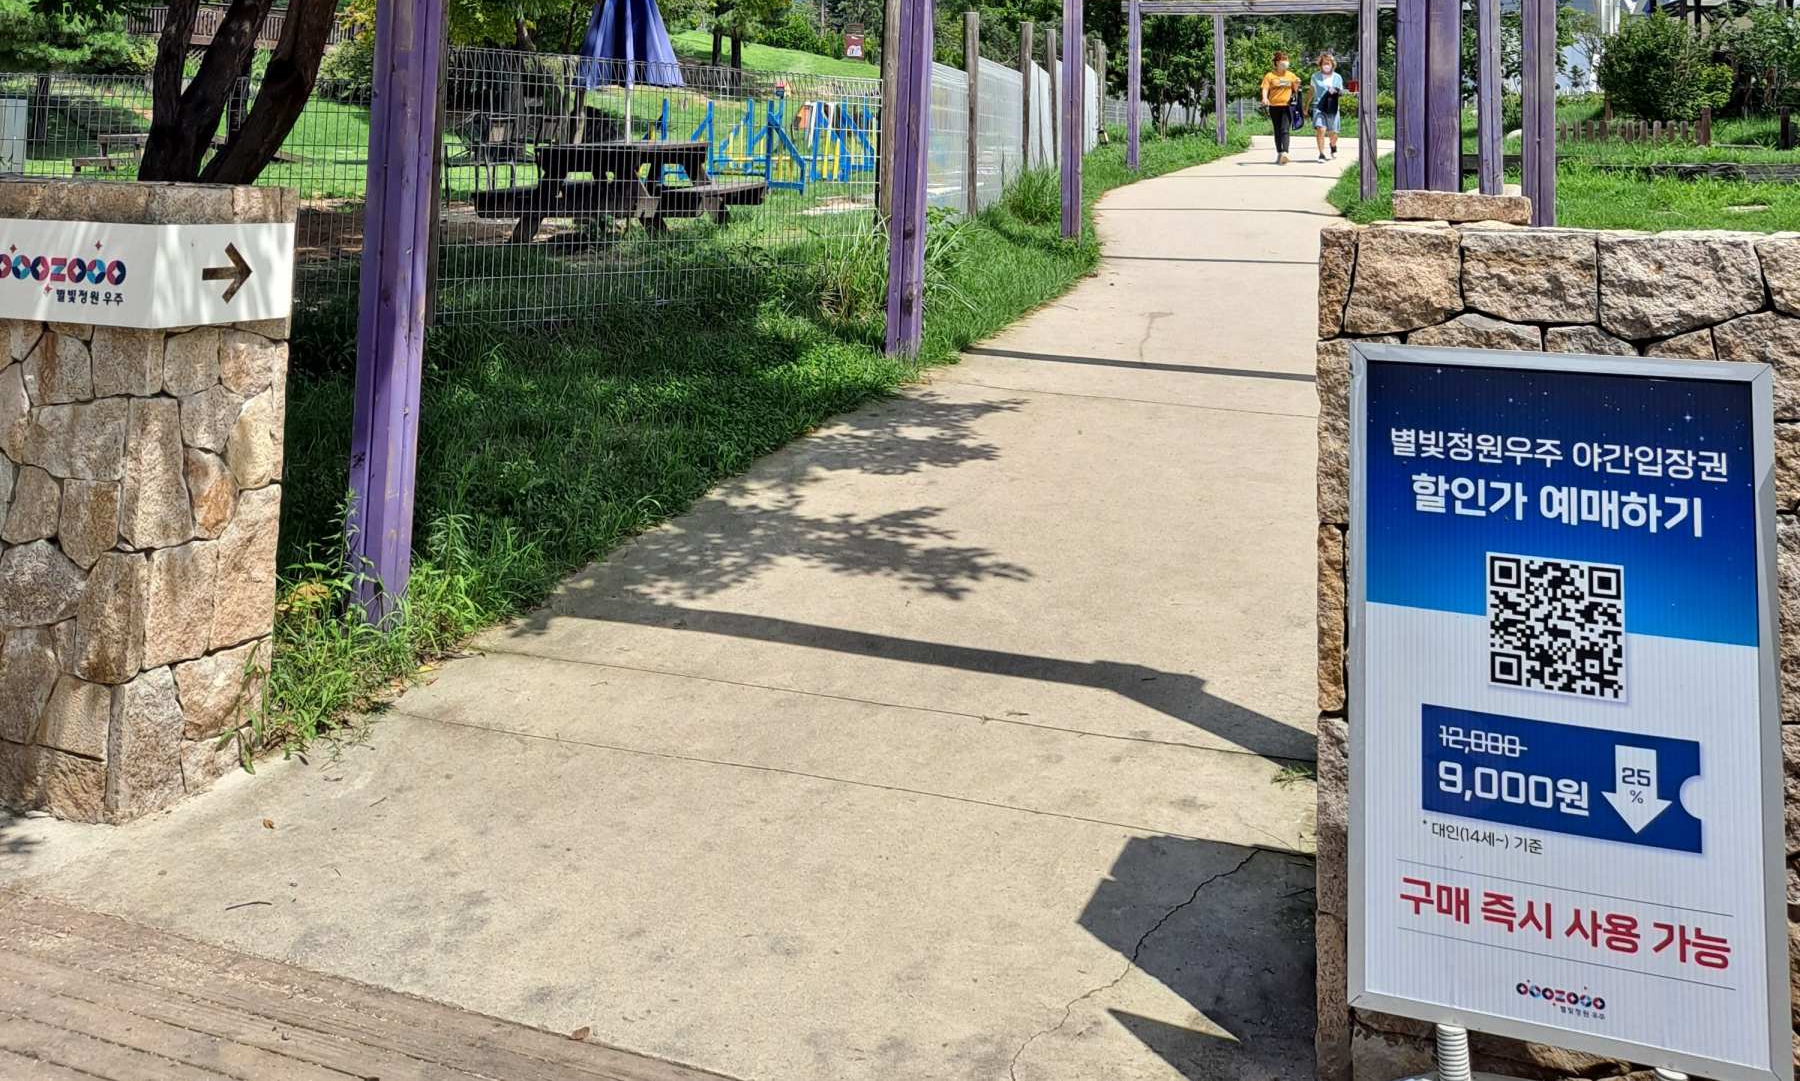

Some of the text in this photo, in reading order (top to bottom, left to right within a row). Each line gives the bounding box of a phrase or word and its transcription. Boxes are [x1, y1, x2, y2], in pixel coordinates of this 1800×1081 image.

[1391, 427, 1729, 483] 별빛정원우주 야간입장권
[1411, 472, 1703, 538] 할인가 예매하기
[1438, 760, 1590, 817] 9,000원
[1621, 766, 1651, 787] 25
[1514, 836, 1543, 855] 기준
[1399, 876, 1732, 970] 구매 즉시 사용 가능
